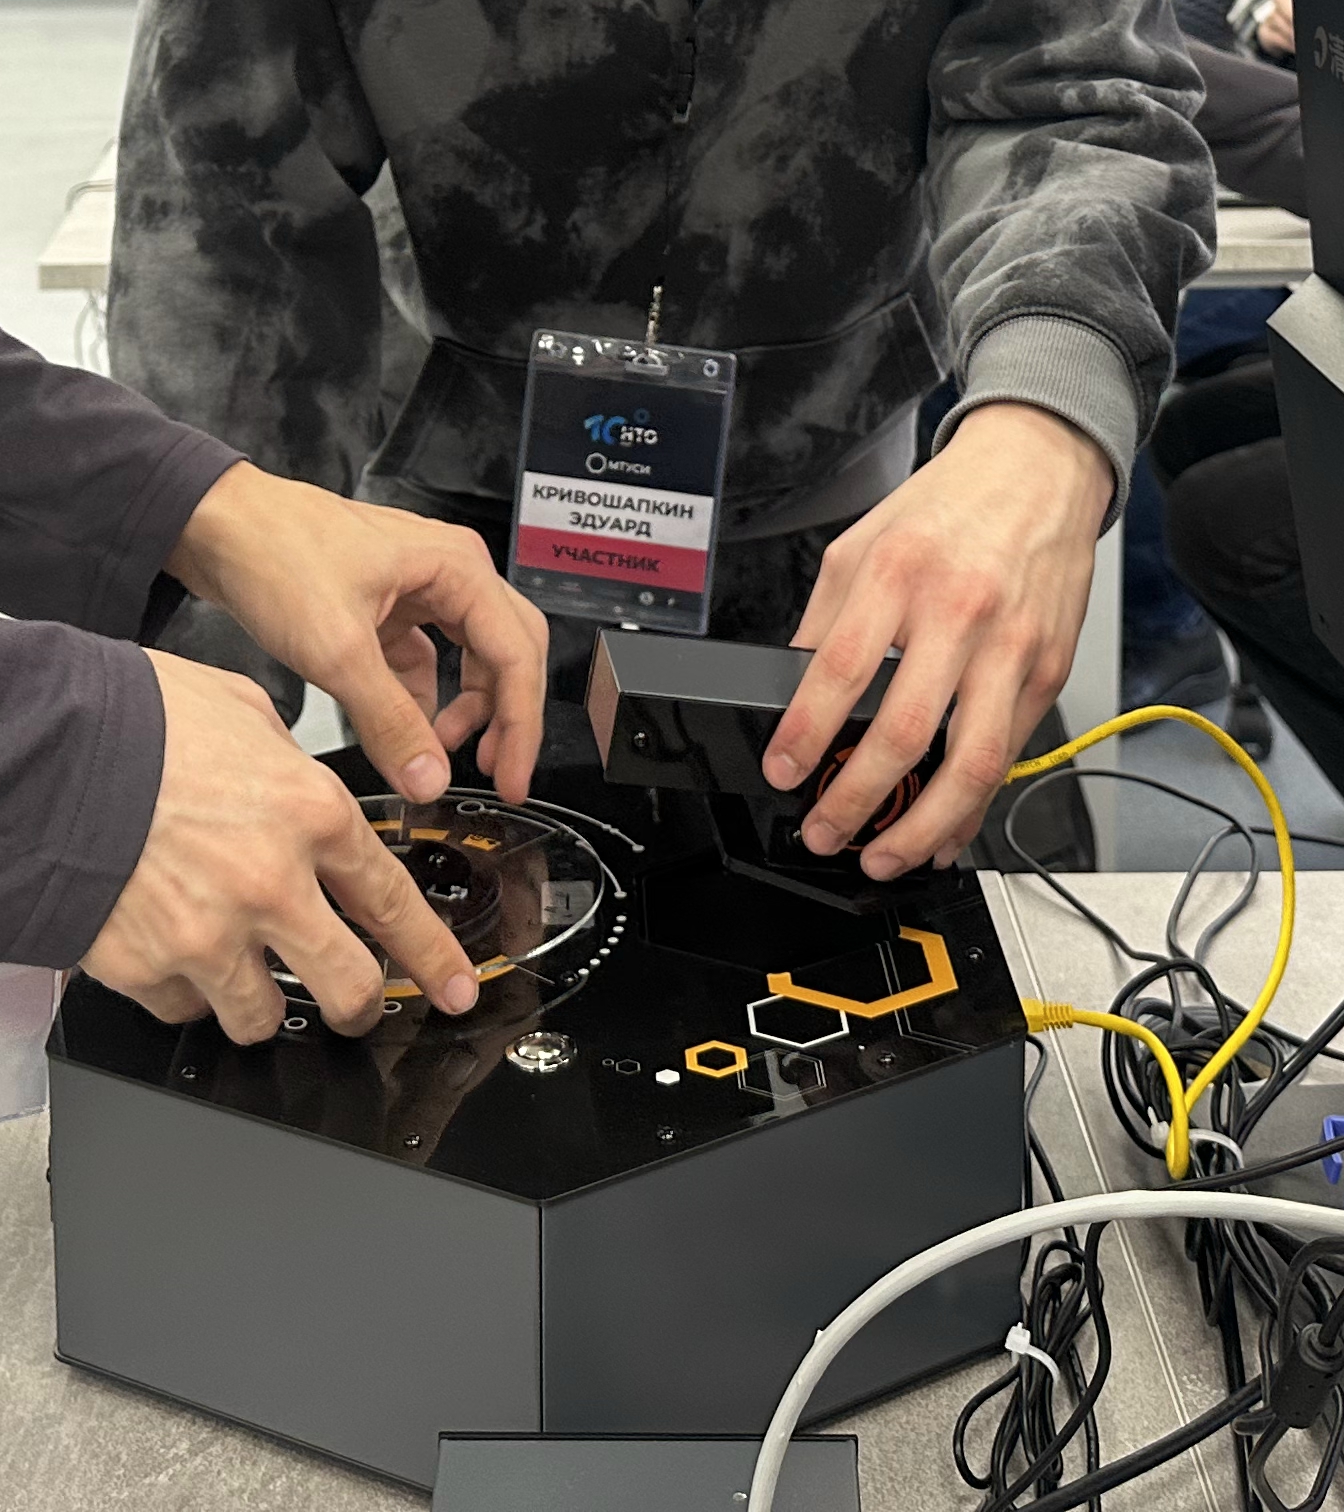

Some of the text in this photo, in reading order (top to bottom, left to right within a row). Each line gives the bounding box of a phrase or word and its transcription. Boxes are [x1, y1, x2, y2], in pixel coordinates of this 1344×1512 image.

[608, 460, 652, 476] МТУСИ
[532, 483, 694, 520] КРИВОШАПКИН
[569, 511, 652, 538] ЭДУАРД
[552, 543, 662, 573] УЧАСТНИК
